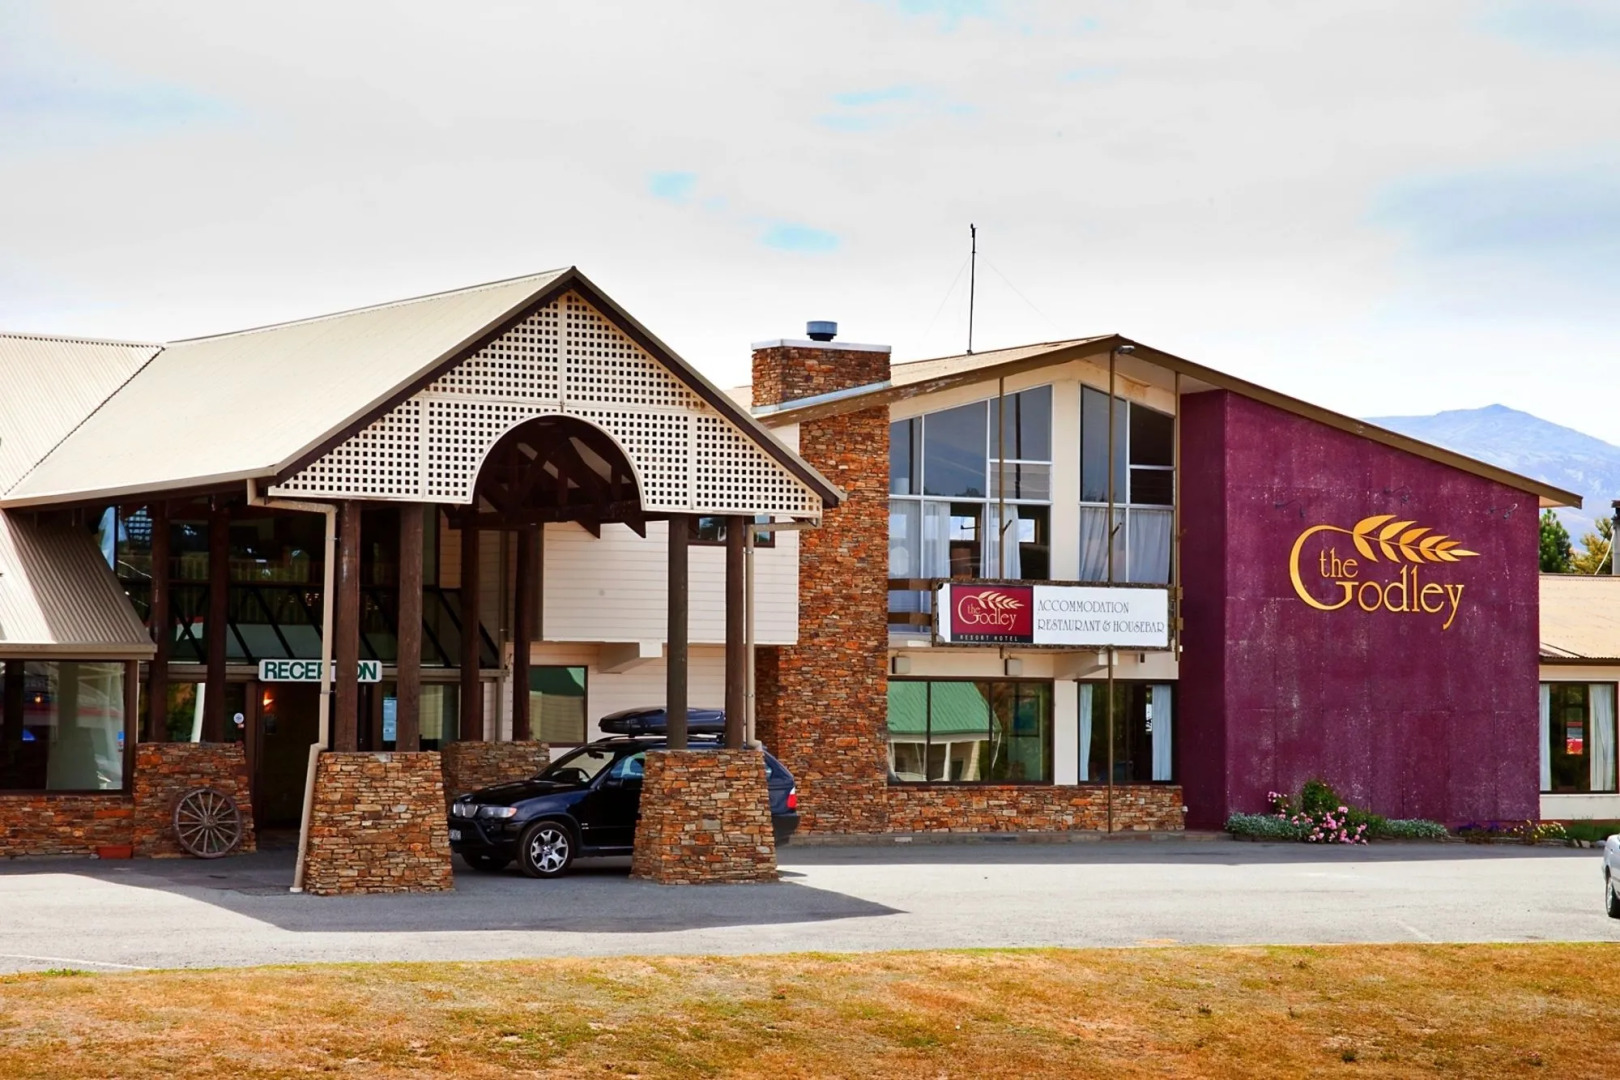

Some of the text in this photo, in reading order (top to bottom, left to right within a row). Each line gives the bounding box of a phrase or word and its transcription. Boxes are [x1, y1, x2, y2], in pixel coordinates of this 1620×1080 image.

[1319, 547, 1358, 578] the
[1289, 525, 1464, 630] Godley
[958, 595, 1017, 631] Godley
[967, 603, 981, 614] the
[1038, 600, 1129, 614] ACCOMMODATION
[1037, 619, 1165, 633] RESTAURANT & HOUSEBAR
[264, 661, 377, 680] RECEN
